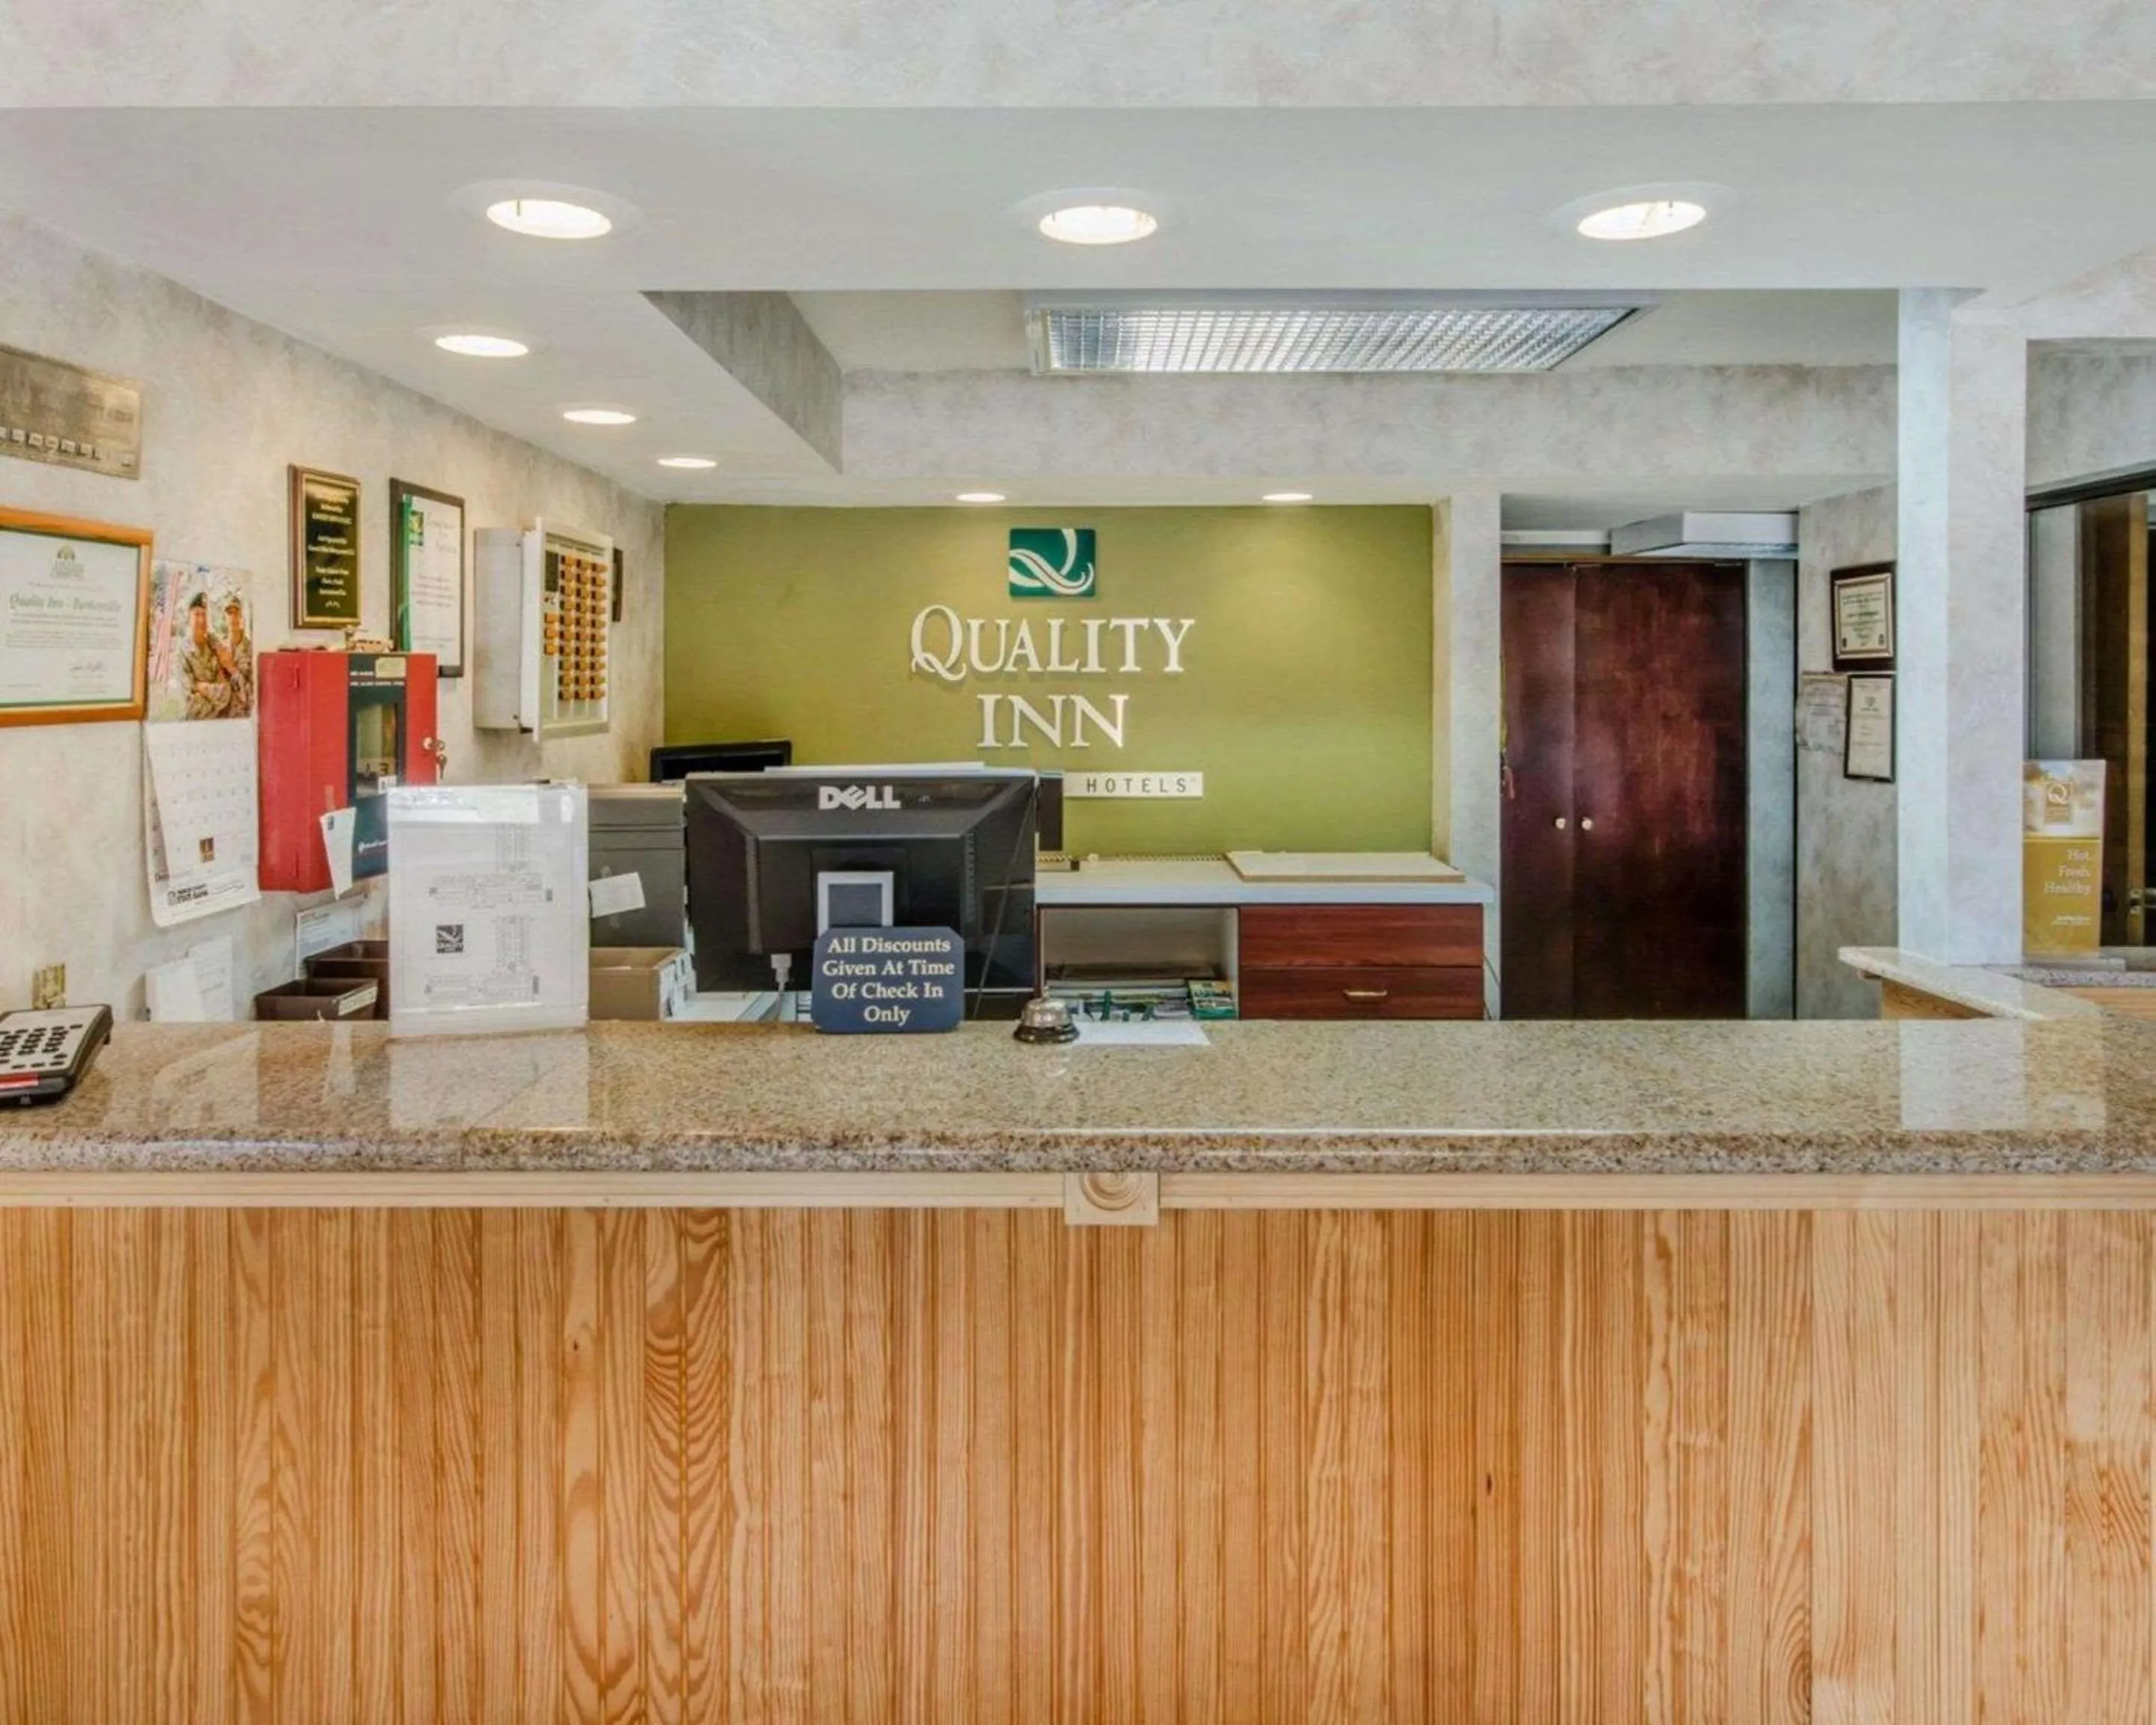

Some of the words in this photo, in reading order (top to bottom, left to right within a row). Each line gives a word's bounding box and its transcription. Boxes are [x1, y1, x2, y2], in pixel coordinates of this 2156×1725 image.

[911, 605, 1195, 681] QUALITY
[977, 694, 1129, 748] INN
[1086, 778, 1187, 793] HOTELS
[818, 785, 901, 811] DELL
[827, 937, 856, 953] All
[862, 937, 951, 953] Discounts
[822, 960, 877, 976] Given
[881, 959, 904, 976] At
[907, 959, 955, 976] Time
[832, 982, 859, 1000] Of
[861, 982, 919, 1000] Check
[923, 982, 944, 999] In
[863, 1005, 912, 1027] Only
